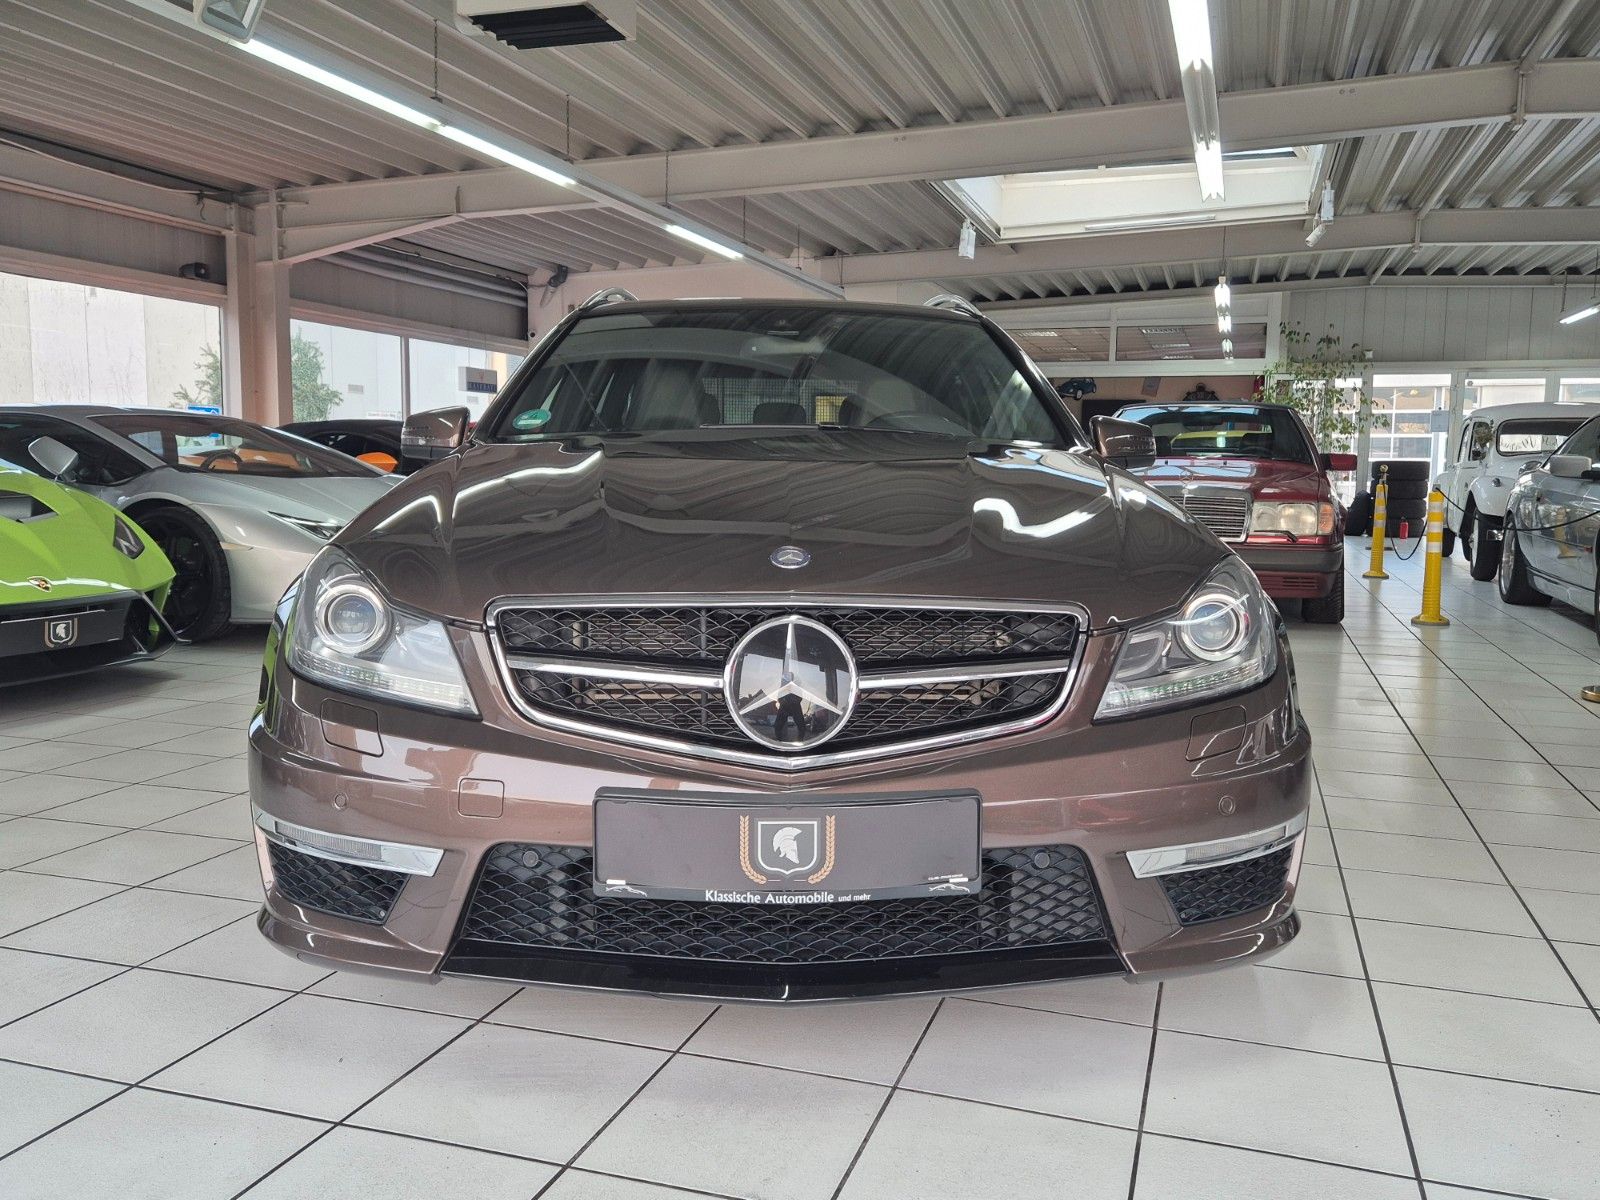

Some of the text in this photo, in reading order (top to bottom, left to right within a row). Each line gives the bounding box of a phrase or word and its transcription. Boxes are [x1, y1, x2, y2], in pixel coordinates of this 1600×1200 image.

[705, 889, 872, 904] Klassische Automobile und mehr
